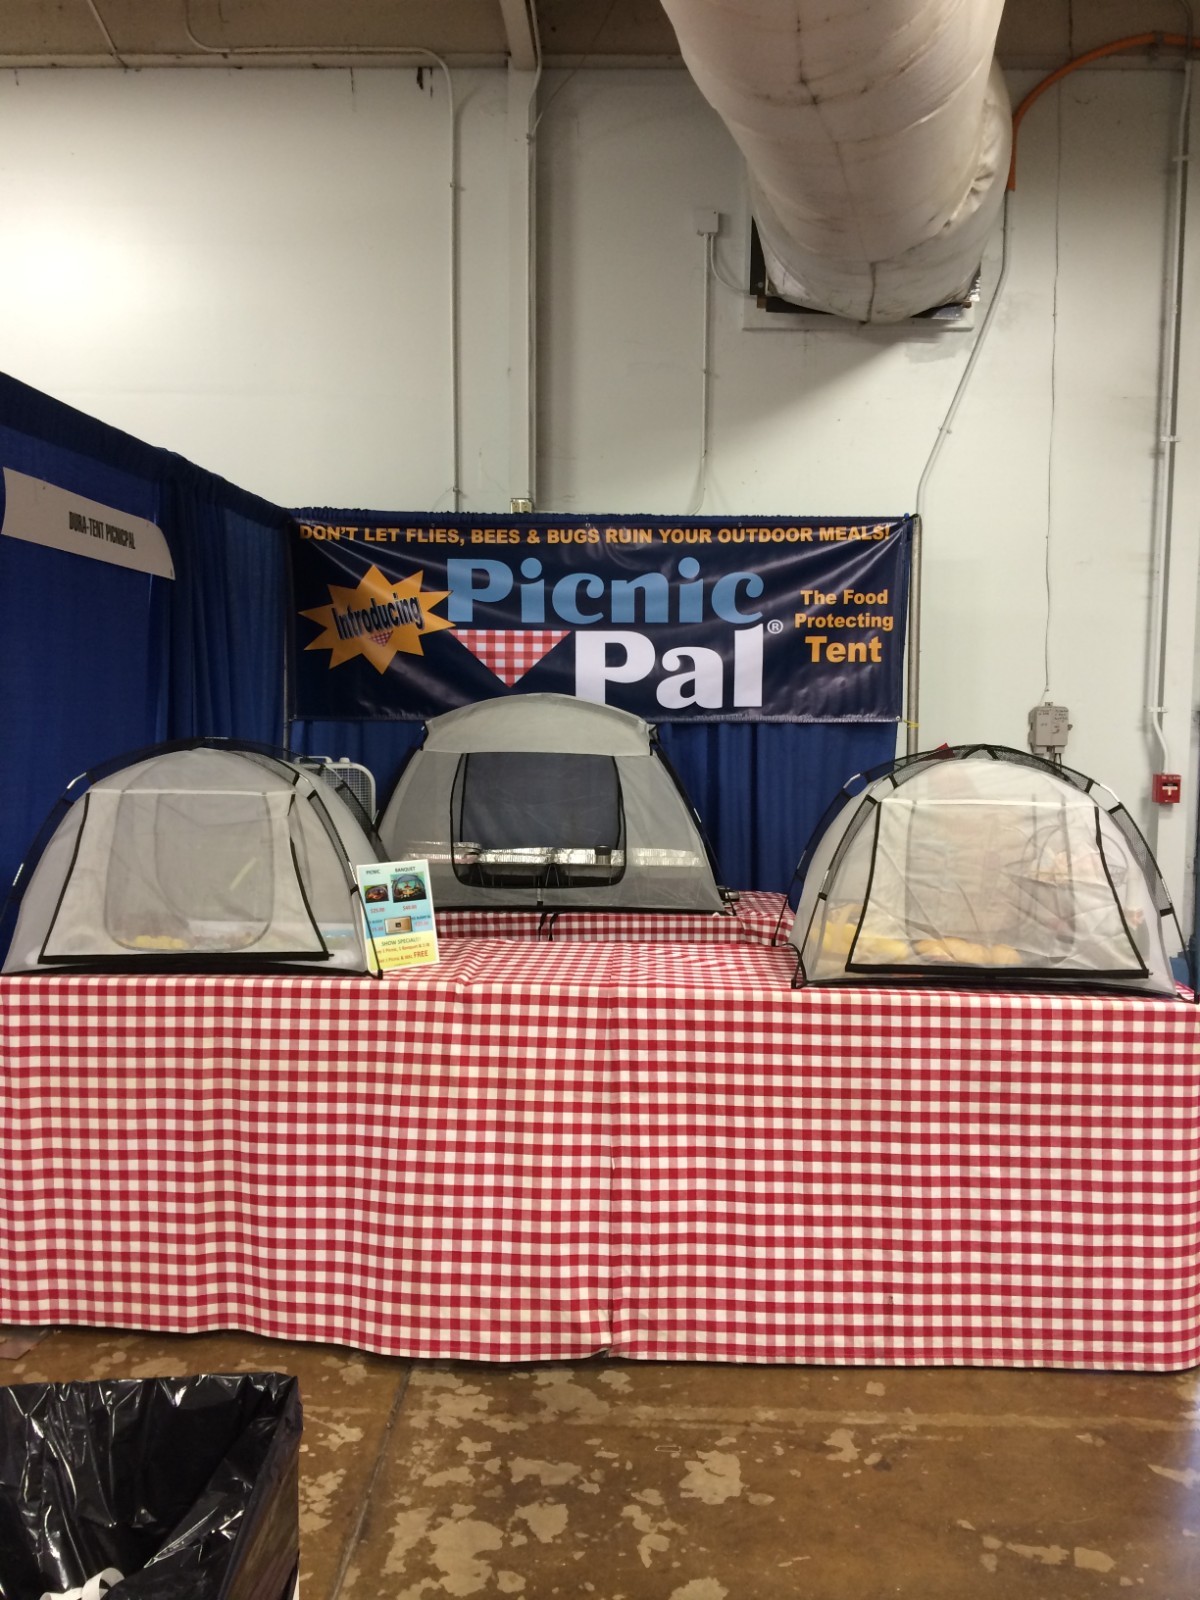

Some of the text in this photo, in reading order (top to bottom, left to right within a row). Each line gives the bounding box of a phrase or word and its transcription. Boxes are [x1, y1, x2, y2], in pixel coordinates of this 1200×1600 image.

[300, 525, 890, 546] DON'T LET FLIES, BEES & BUGS RUIN YOUR OUTDOOR MEALS!
[447, 556, 764, 625] Picnic
[800, 589, 888, 605] The Food
[331, 592, 424, 639] Introducing
[794, 613, 894, 632] Protecting
[805, 636, 882, 663] Tent
[575, 623, 764, 710] Pal
[413, 950, 429, 959] FREE
